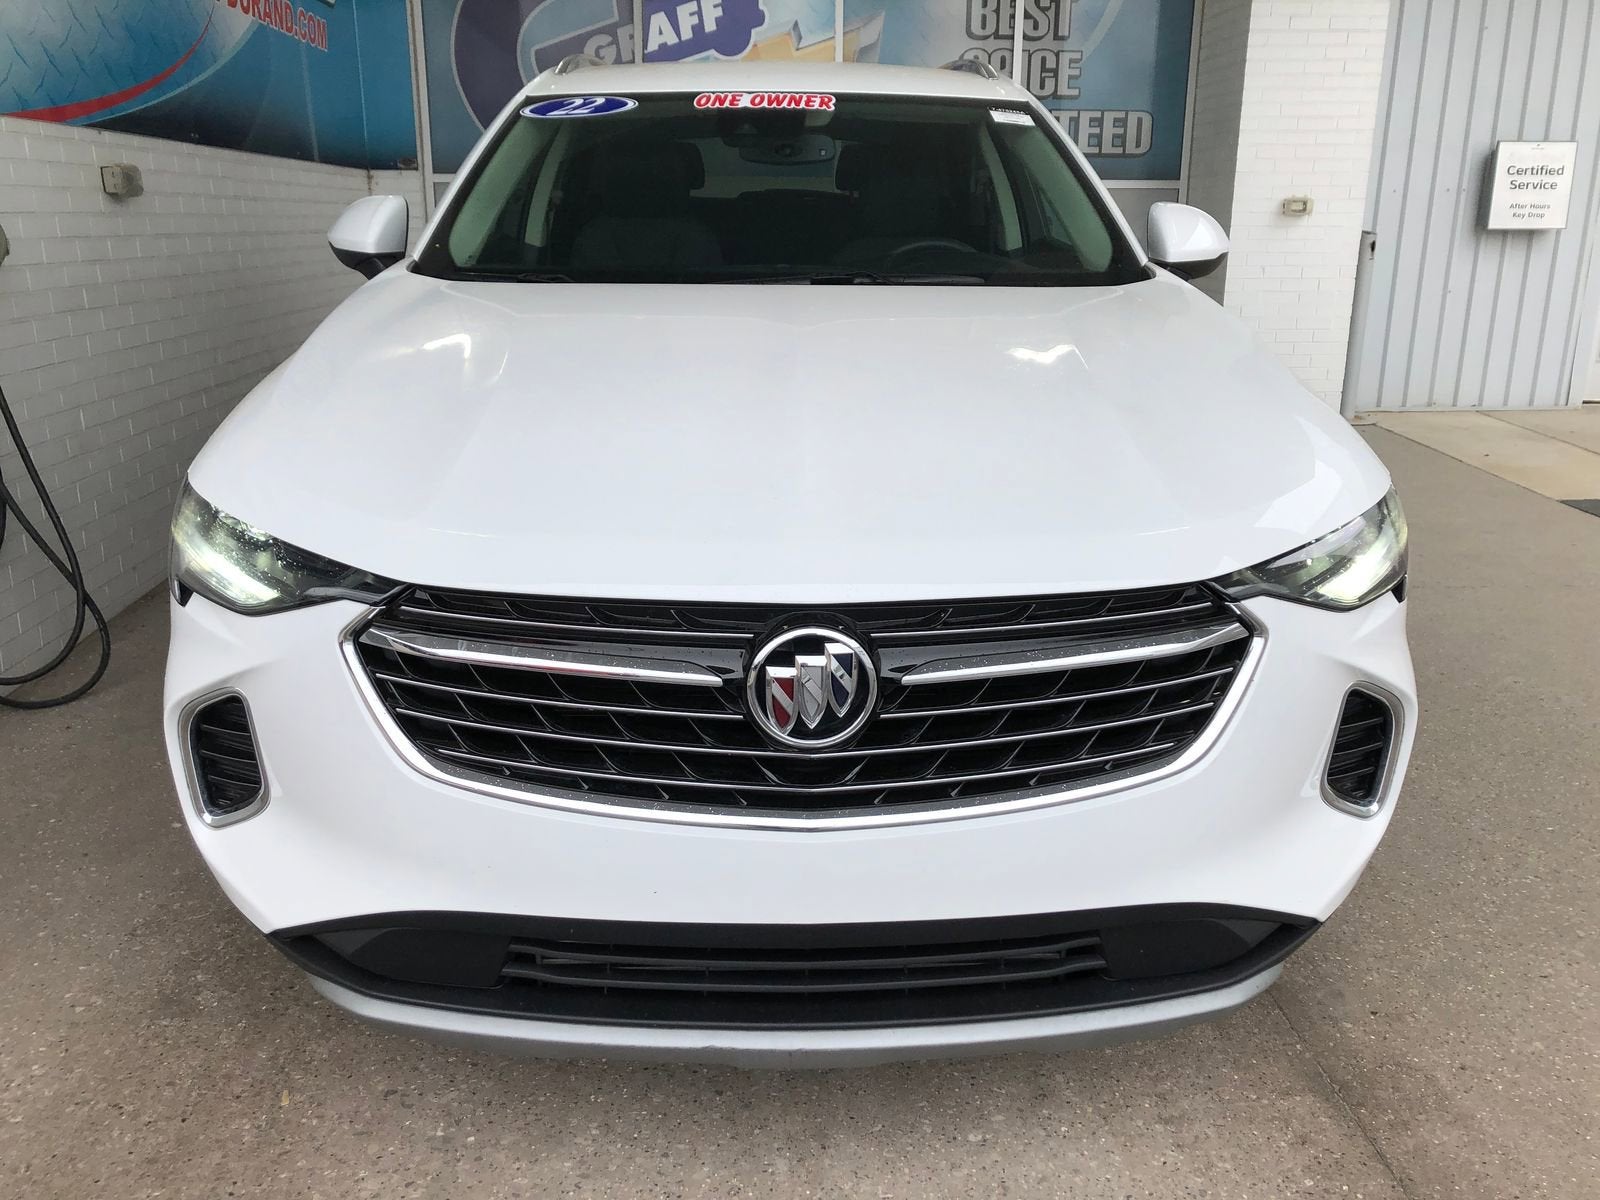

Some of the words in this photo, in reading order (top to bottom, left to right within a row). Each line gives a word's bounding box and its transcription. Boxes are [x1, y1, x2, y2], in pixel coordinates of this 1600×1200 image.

[226, 0, 328, 51] URAND.COM
[966, 0, 1072, 40] BEST
[959, 48, 1082, 99] RICE
[545, 97, 606, 116] 22
[694, 92, 743, 108] ONE
[749, 92, 835, 110] OWNER
[1507, 164, 1565, 176] Certified
[1509, 179, 1558, 190] Service
[1512, 211, 1526, 220] Key
[1527, 211, 1546, 219] Drop
